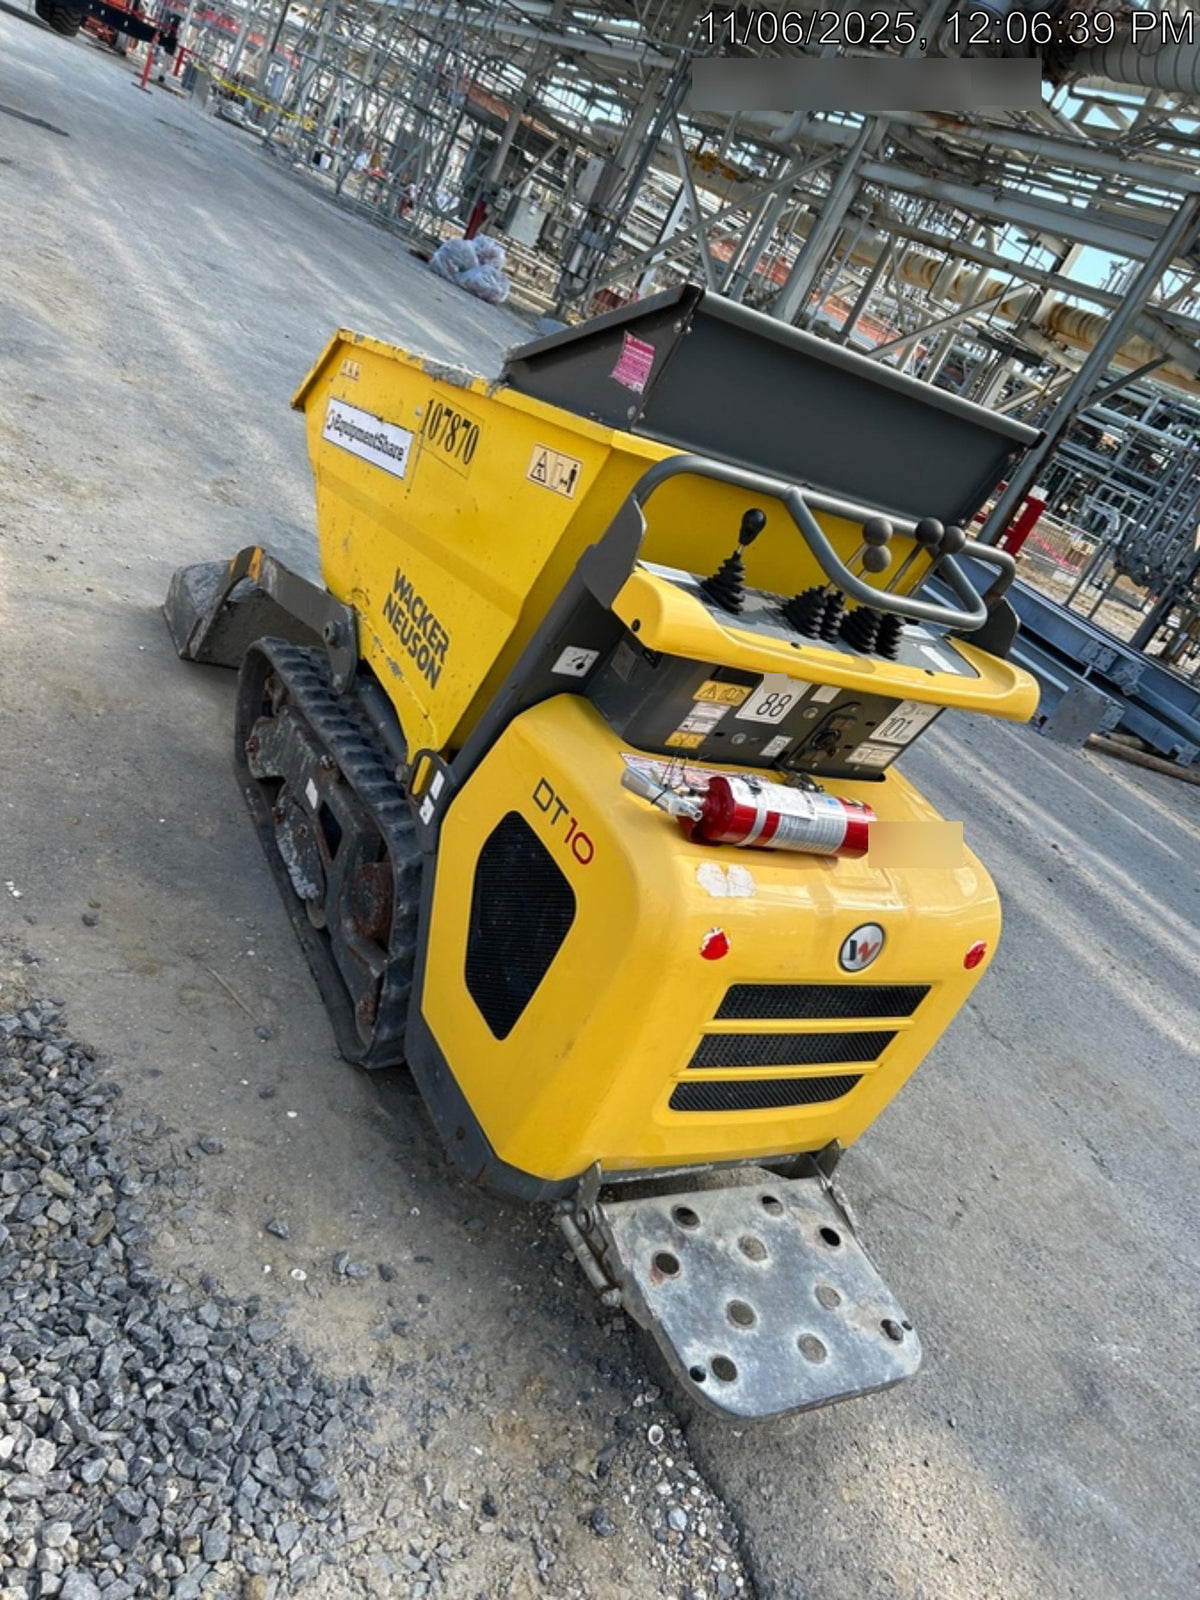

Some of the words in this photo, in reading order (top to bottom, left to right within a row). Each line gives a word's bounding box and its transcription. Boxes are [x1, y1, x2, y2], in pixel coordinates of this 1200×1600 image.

[333, 413, 405, 462] EquipmentShare
[421, 399, 480, 466] 107870
[382, 592, 442, 690] NEUSON
[393, 567, 450, 665] WACKER
[756, 692, 793, 717] 88
[532, 777, 595, 865] DT10
